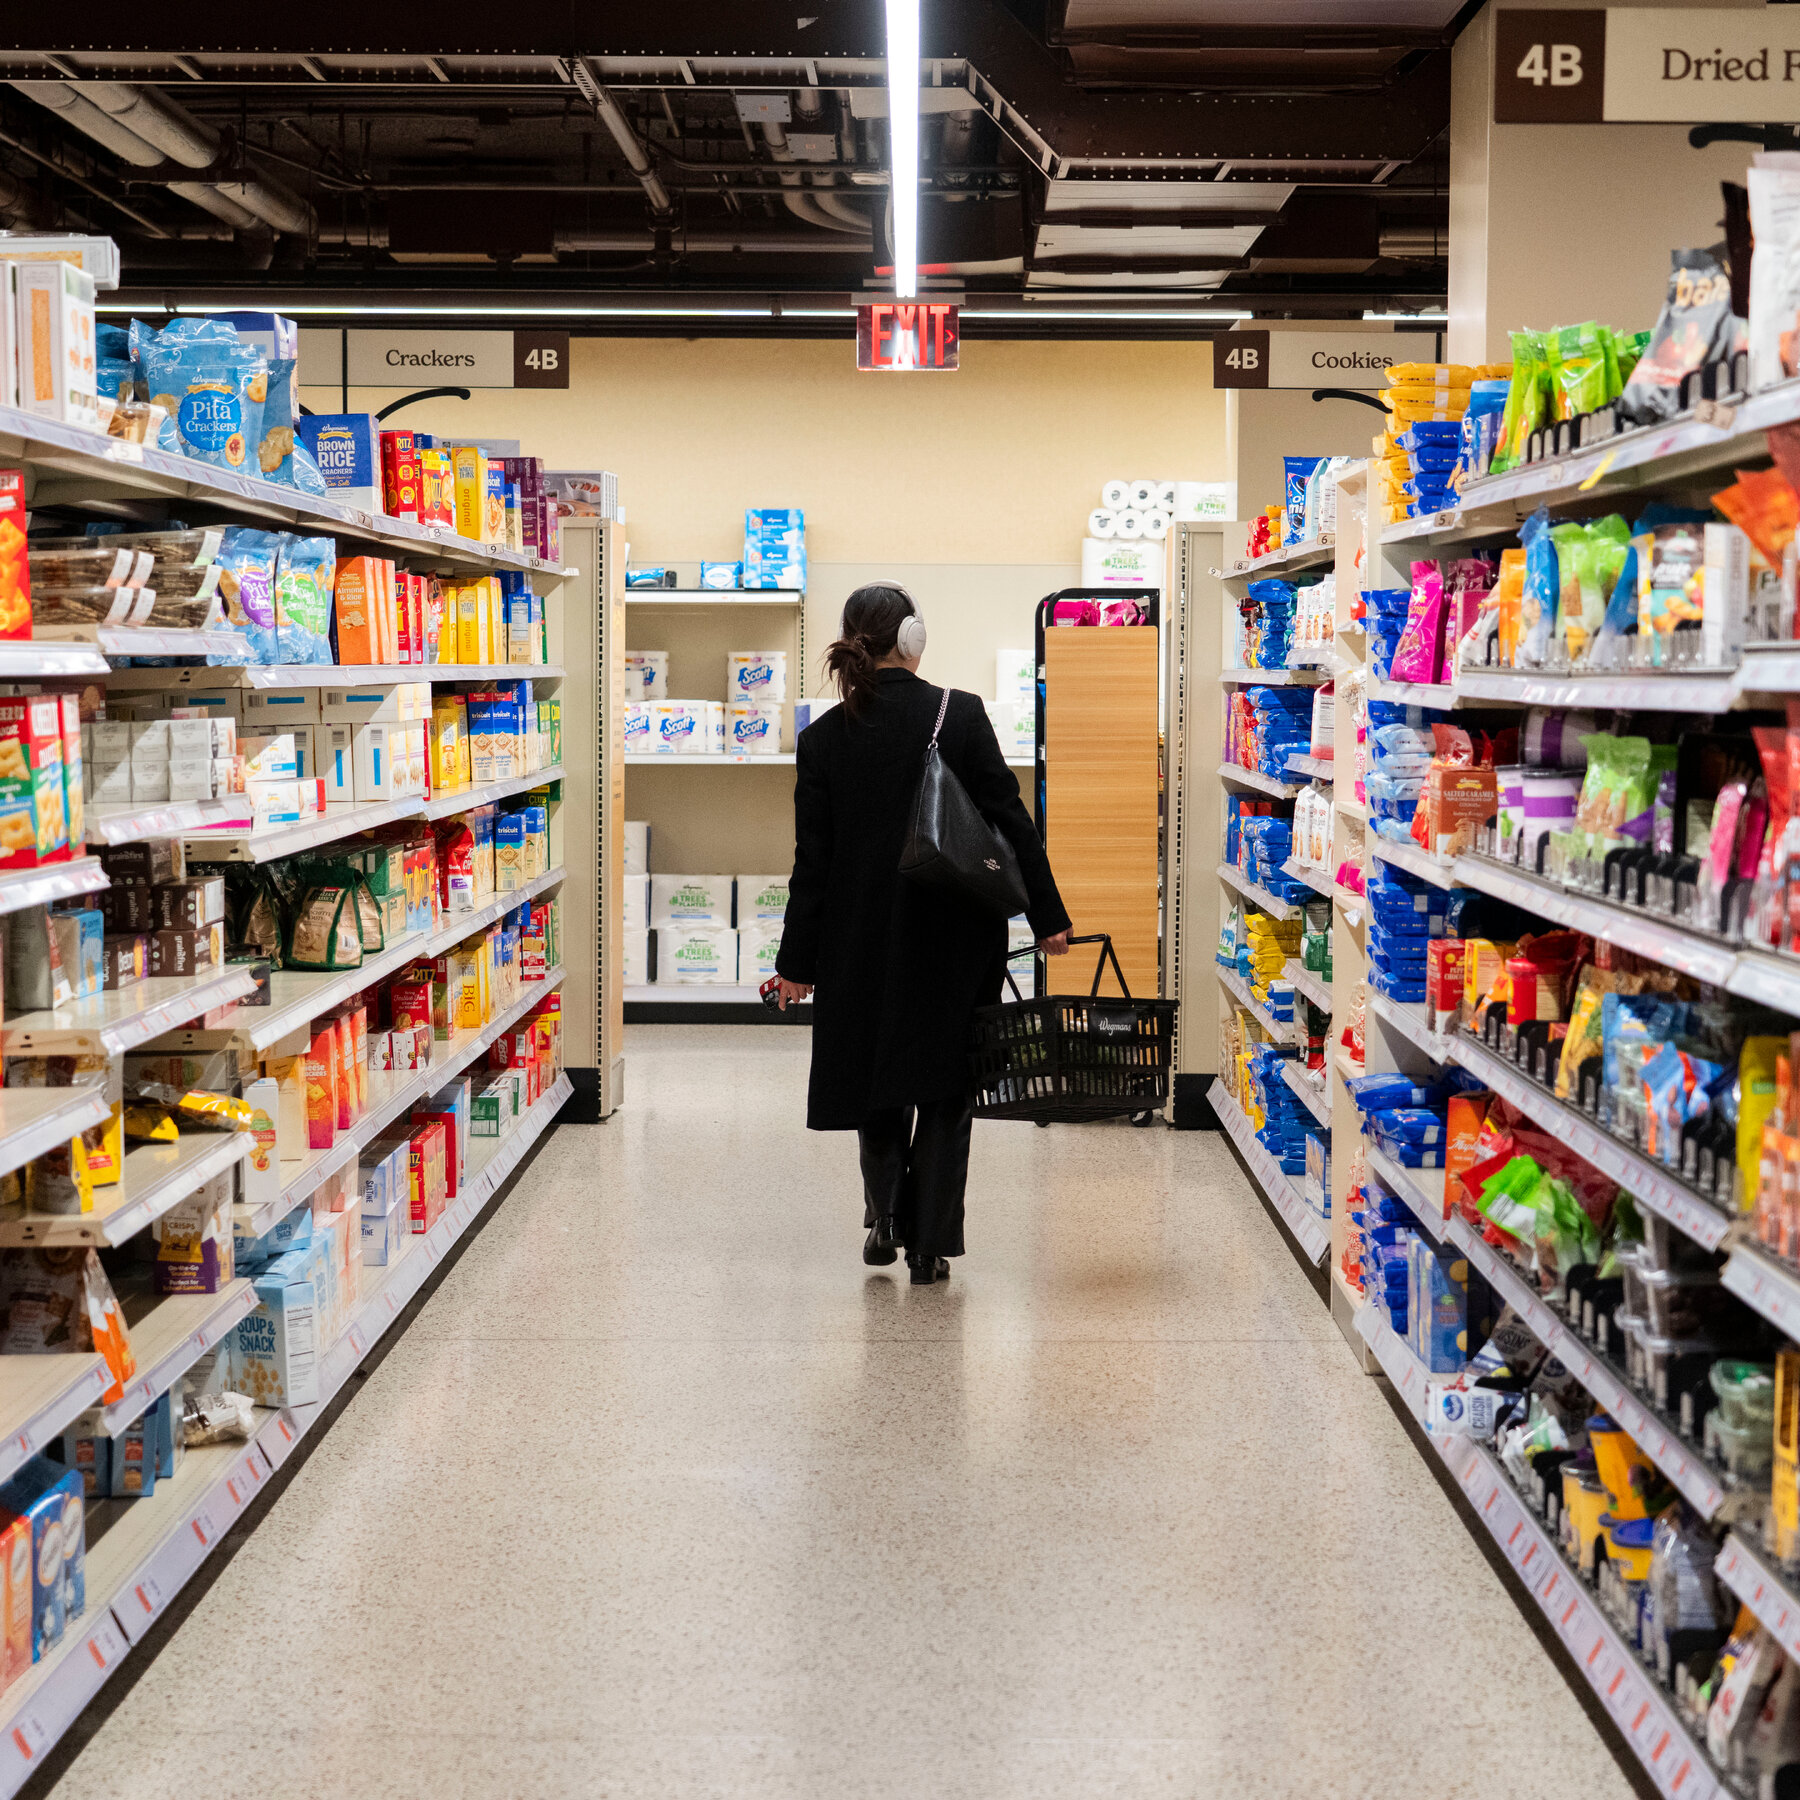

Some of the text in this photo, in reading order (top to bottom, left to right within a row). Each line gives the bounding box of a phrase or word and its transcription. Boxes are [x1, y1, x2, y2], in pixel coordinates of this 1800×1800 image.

[1516, 43, 1584, 87] 4B
[1661, 47, 1770, 82] Dried
[871, 303, 951, 366] EXIT
[385, 348, 476, 368] Crackers
[524, 348, 559, 370] 4B
[1224, 348, 1260, 370] 4B
[1311, 351, 1394, 370] Cookies
[191, 400, 232, 420] Pita
[185, 420, 238, 432] Crackers
[316, 439, 356, 452] BROWN
[396, 437, 412, 450] RITZ
[318, 450, 356, 468] RICE
[462, 488, 472, 527] original
[1438, 514, 1447, 527] 5
[433, 528, 442, 538] 8
[1321, 535, 1328, 545] 6
[490, 545, 497, 554] 9
[531, 559, 540, 567] 10
[1112, 557, 1138, 565] TREES
[1237, 562, 1243, 570] 8
[337, 586, 365, 594] Almond
[742, 664, 769, 684] Scott
[492, 710, 511, 718] triscuit
[664, 716, 692, 735] Scott
[737, 717, 765, 737] Scott
[1443, 790, 1495, 798] SALTED CARAMEL
[497, 826, 519, 834] triscuit
[680, 894, 706, 902] TREES
[686, 948, 712, 956] TREES
[412, 968, 437, 981] RITZ
[1098, 1017, 1132, 1036] Wegmans
[168, 1221, 196, 1230] CRISPS
[237, 1316, 277, 1336] SOUP &
[239, 1334, 276, 1353] SNACK
